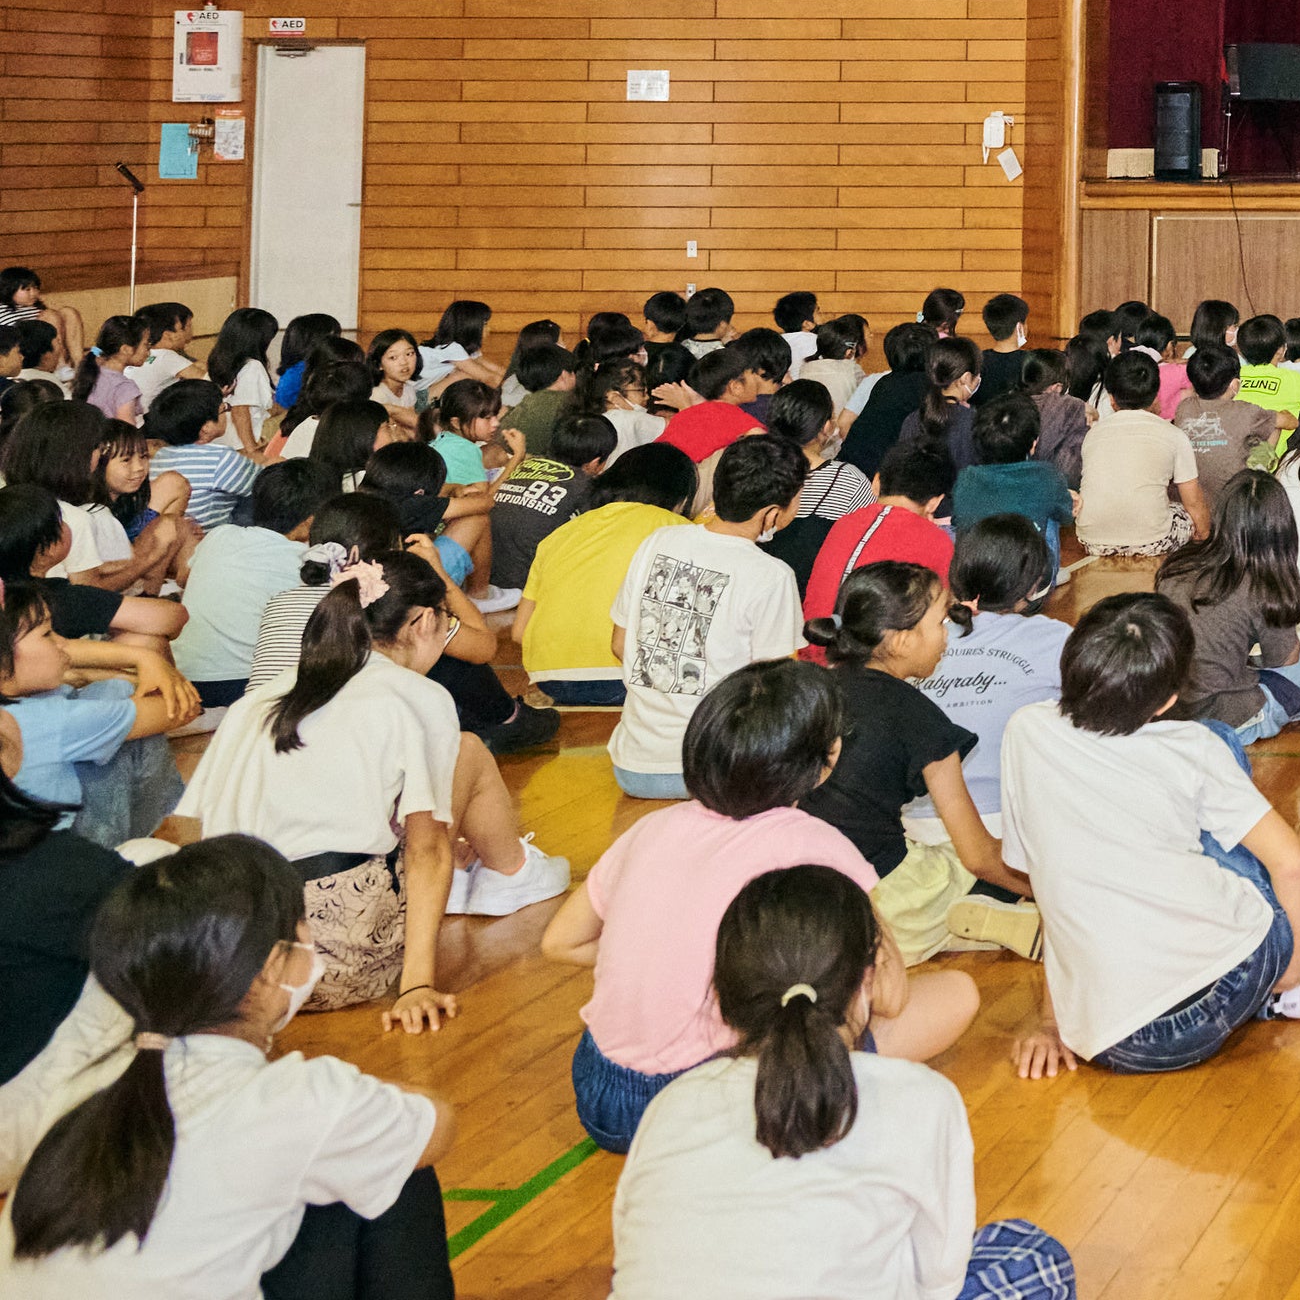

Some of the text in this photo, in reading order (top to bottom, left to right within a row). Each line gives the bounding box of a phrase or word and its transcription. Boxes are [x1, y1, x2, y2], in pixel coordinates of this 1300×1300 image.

[199, 12, 220, 20] AED
[281, 20, 304, 29] AED
[523, 480, 568, 507] 93
[986, 647, 1035, 677] STRUGGLE
